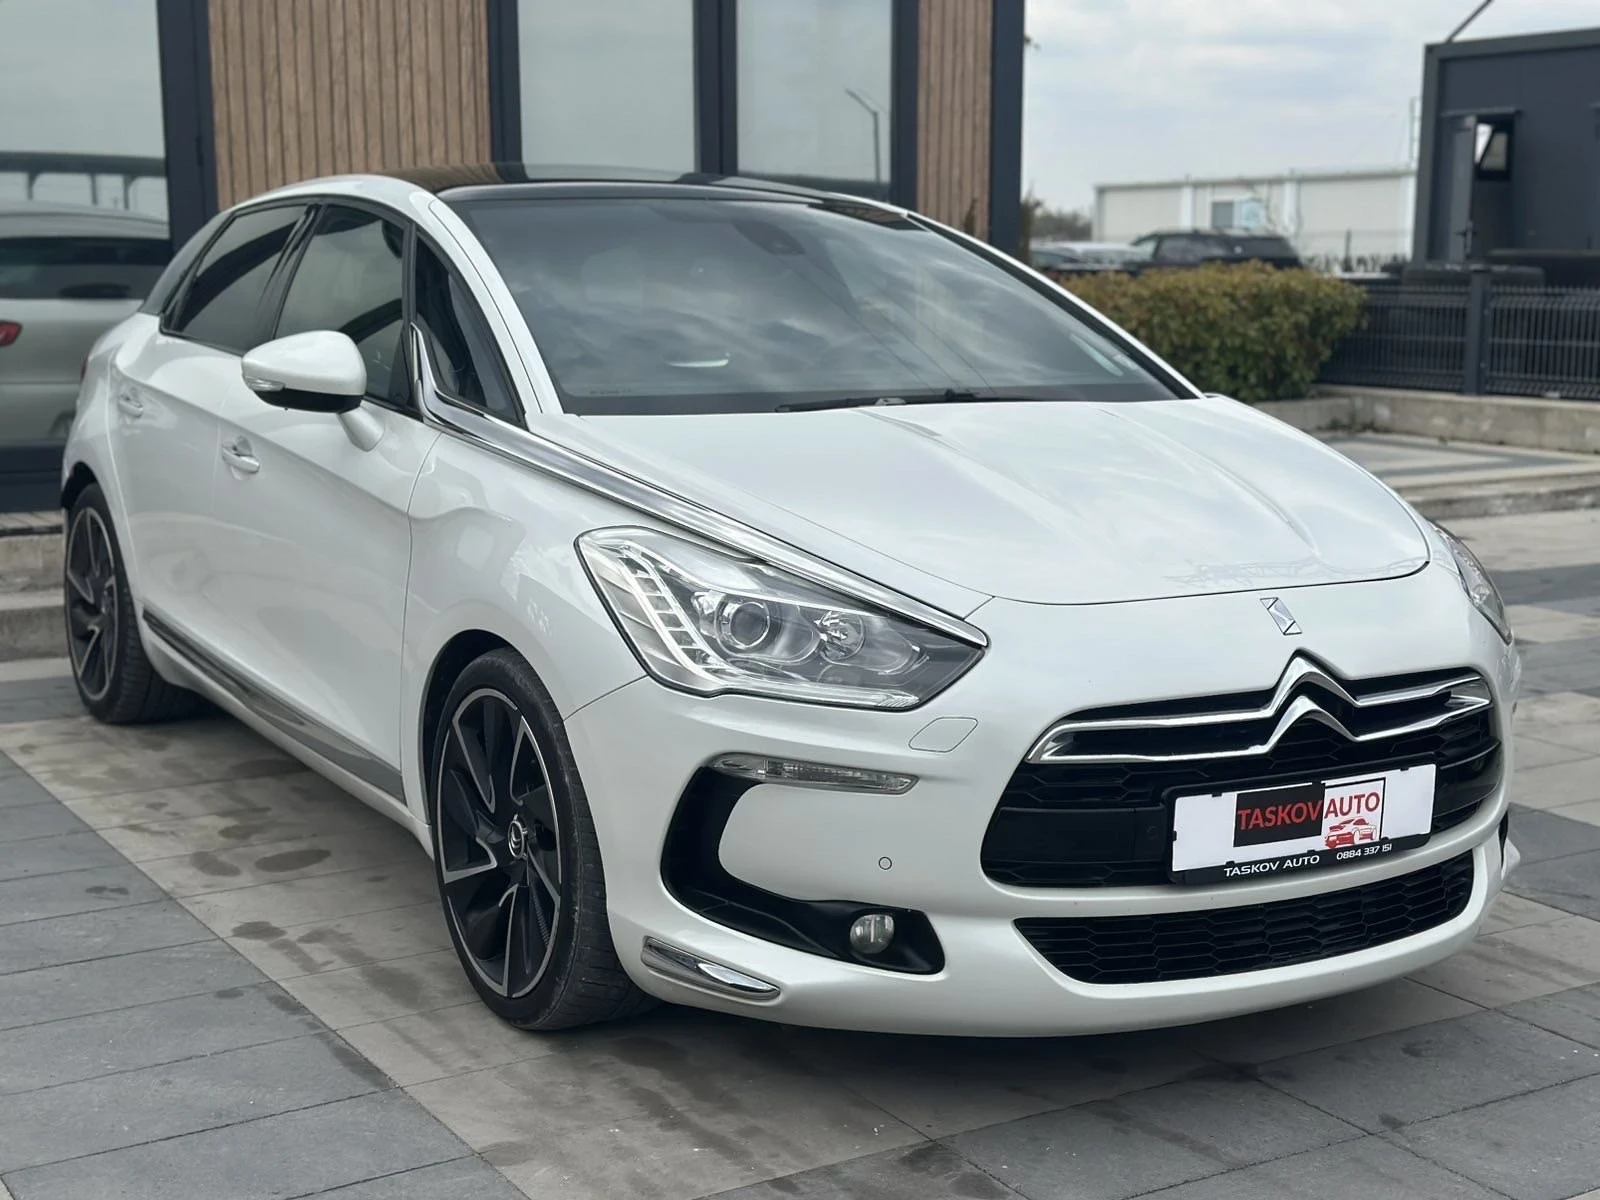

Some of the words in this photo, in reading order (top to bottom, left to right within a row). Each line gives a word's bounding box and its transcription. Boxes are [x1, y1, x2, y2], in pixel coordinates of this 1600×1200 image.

[1237, 800, 1323, 831] TASKOV
[1324, 791, 1380, 819] AUTO
[1224, 861, 1280, 877] TASKOV
[1282, 855, 1320, 869] AUTO
[1336, 849, 1362, 861] 0884
[1364, 847, 1379, 857] 337
